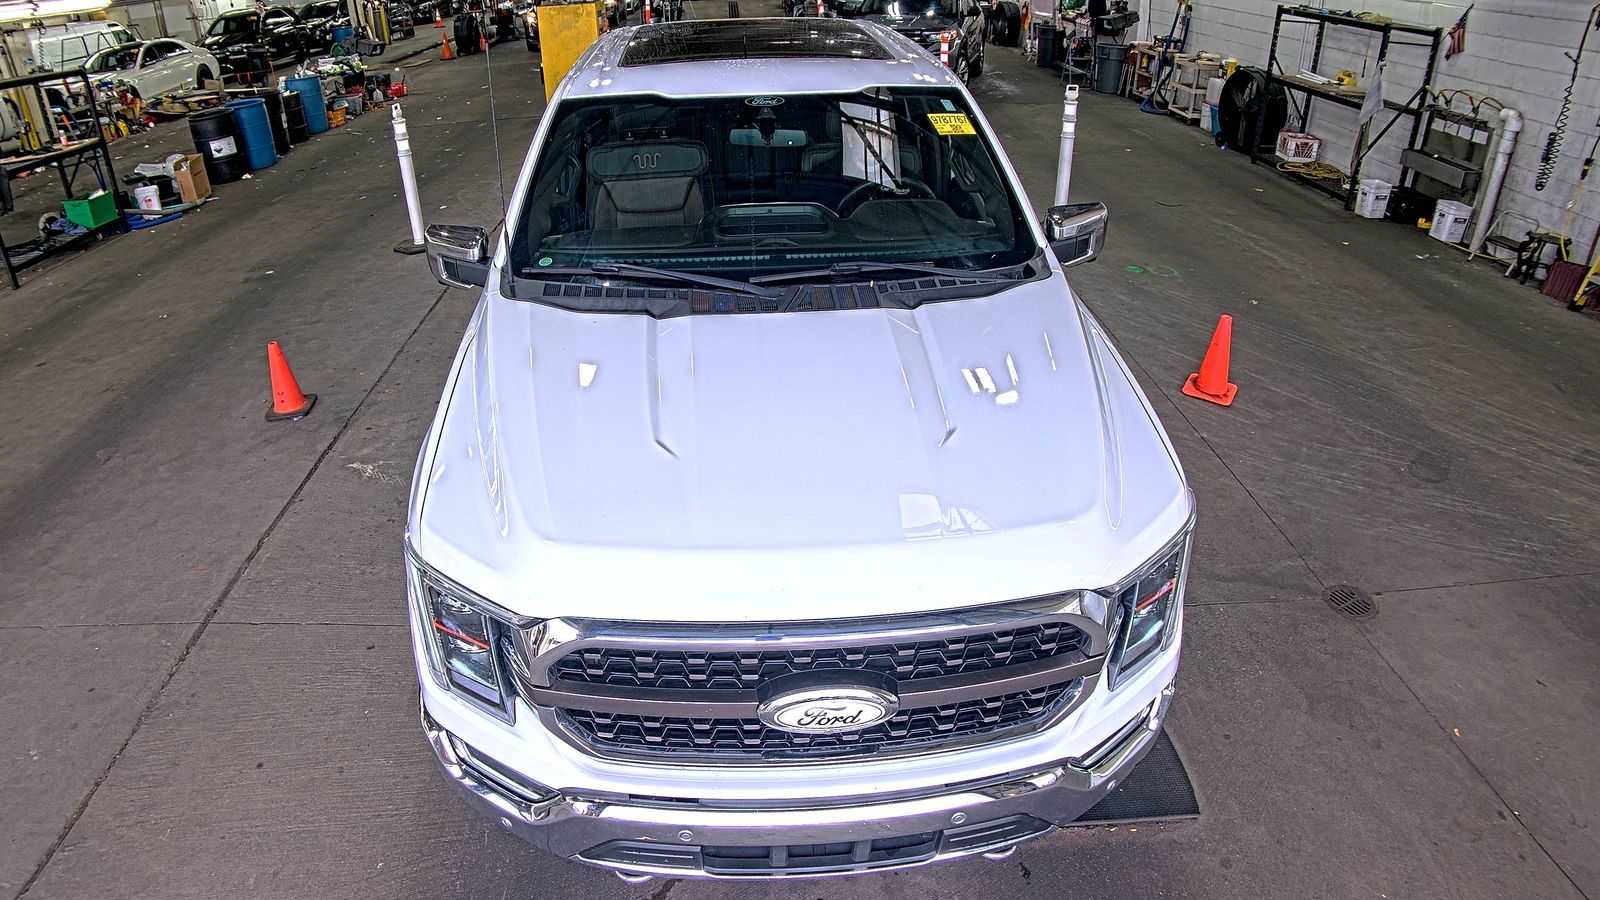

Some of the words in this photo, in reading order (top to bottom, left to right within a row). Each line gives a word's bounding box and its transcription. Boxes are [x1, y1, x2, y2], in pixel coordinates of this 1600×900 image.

[751, 96, 778, 105] Ford
[930, 115, 968, 124] 9787767
[797, 706, 863, 726] Ford
